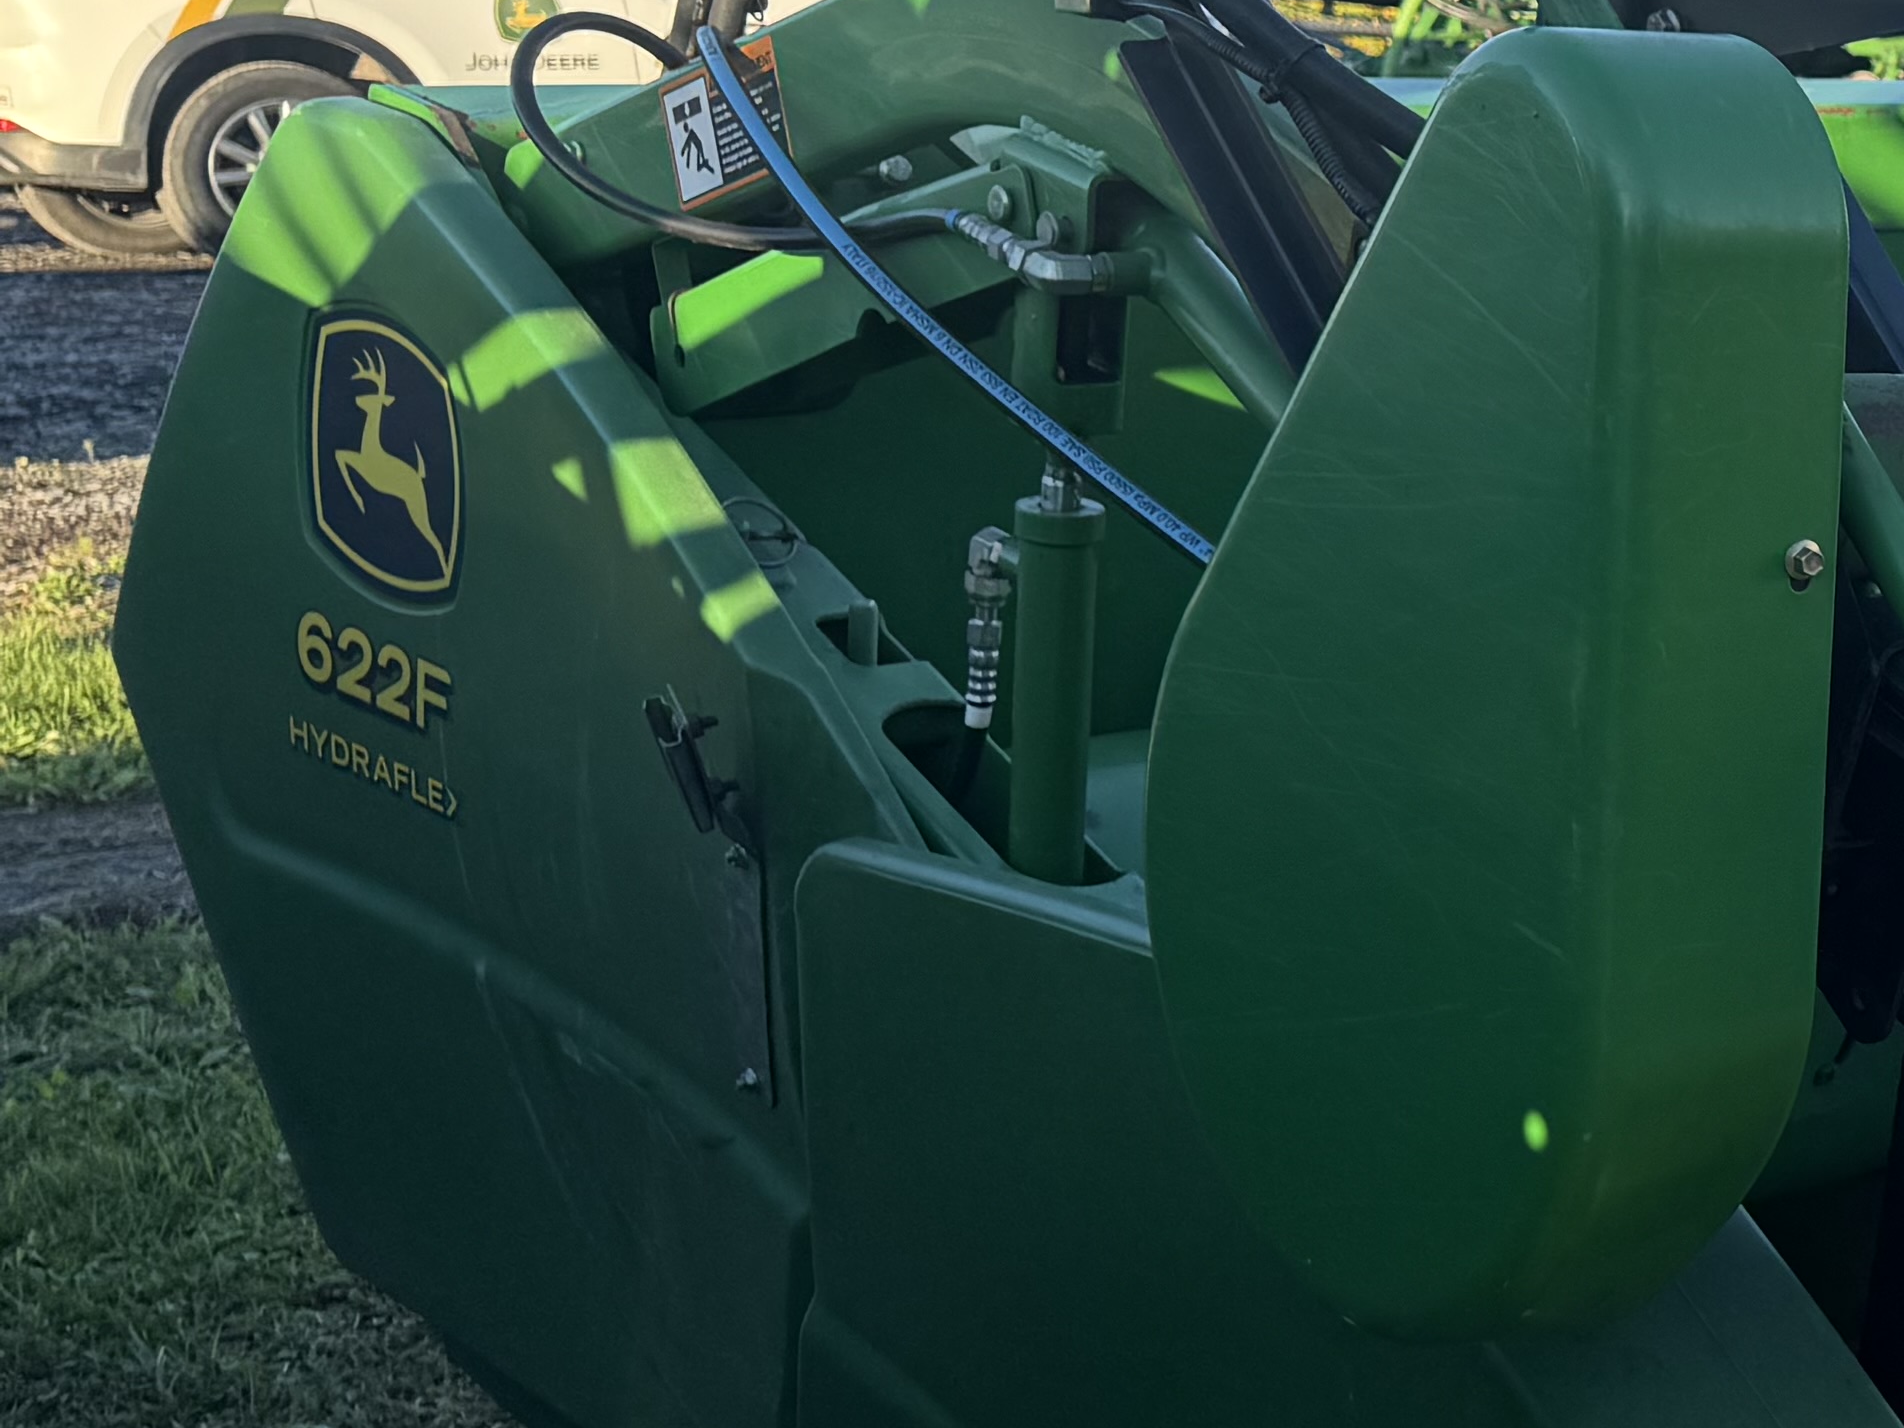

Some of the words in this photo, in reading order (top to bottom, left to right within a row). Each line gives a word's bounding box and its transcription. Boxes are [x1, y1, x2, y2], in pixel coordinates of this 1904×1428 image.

[842, 242, 871, 269] ITALY
[999, 387, 1018, 403] EN
[1060, 436, 1085, 458] SAE
[297, 611, 452, 730] 622F
